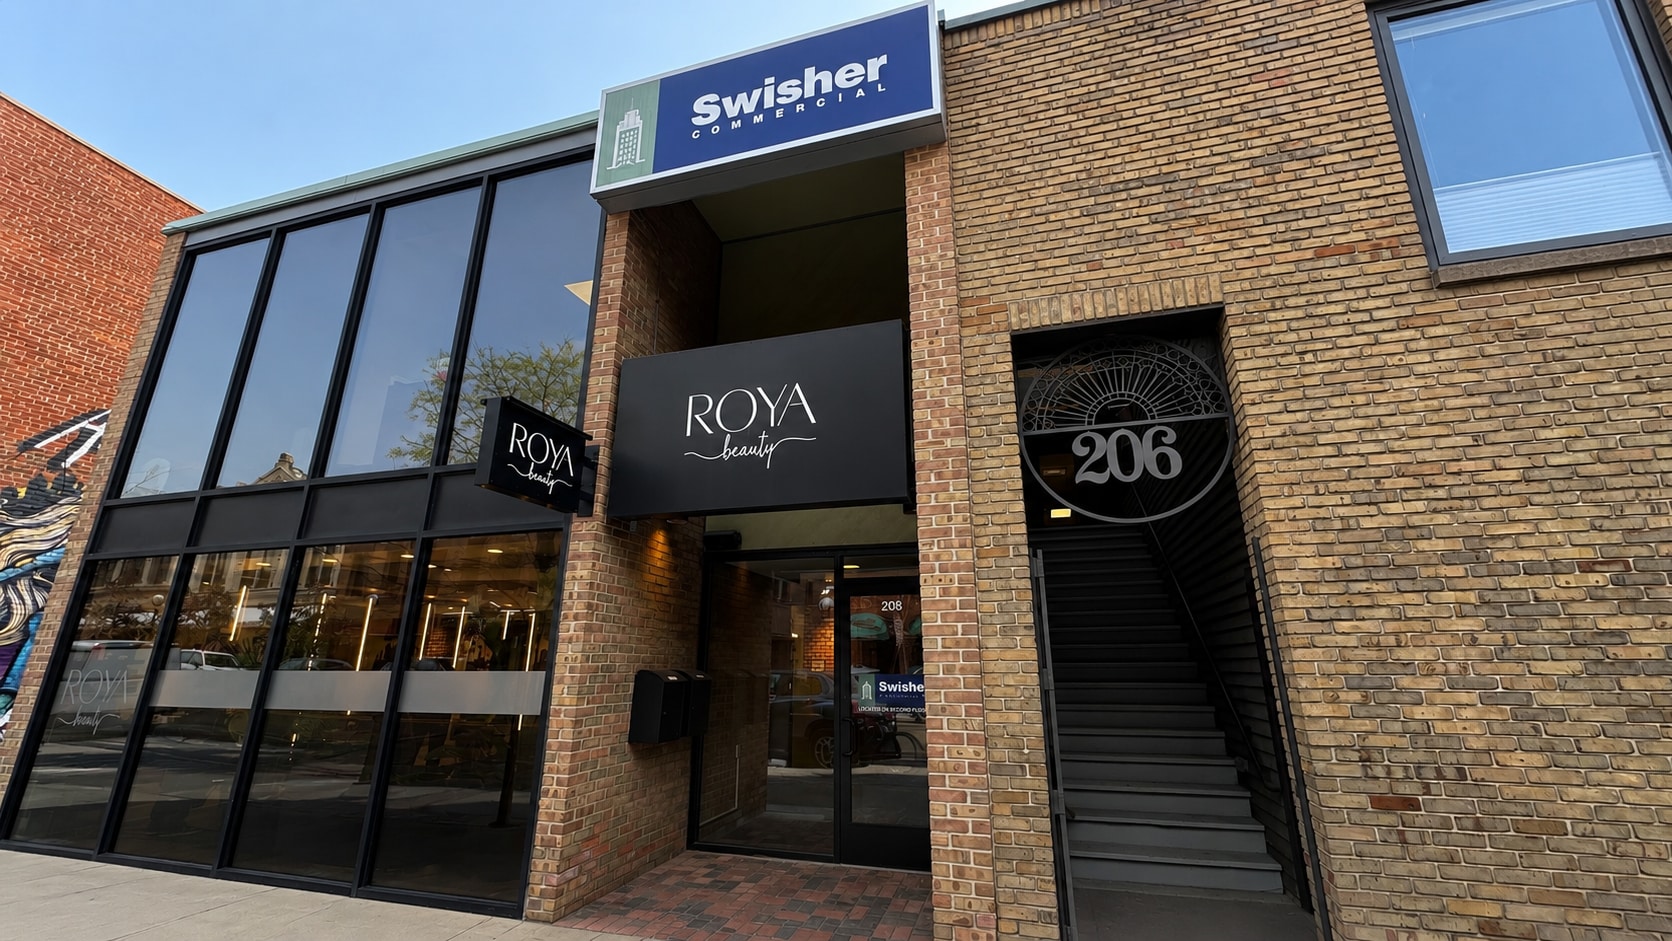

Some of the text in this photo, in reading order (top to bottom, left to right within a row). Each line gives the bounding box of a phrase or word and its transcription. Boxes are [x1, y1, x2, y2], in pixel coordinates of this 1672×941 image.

[691, 54, 888, 126] Swisher
[691, 83, 887, 140] COMMERCIAL
[686, 382, 817, 437] ROYA
[509, 422, 574, 477] ROYA
[684, 430, 817, 469] beauty
[1071, 425, 1183, 484] 206
[881, 600, 903, 612] 208
[60, 669, 128, 705] ROYA
[879, 681, 925, 692] Swishe
